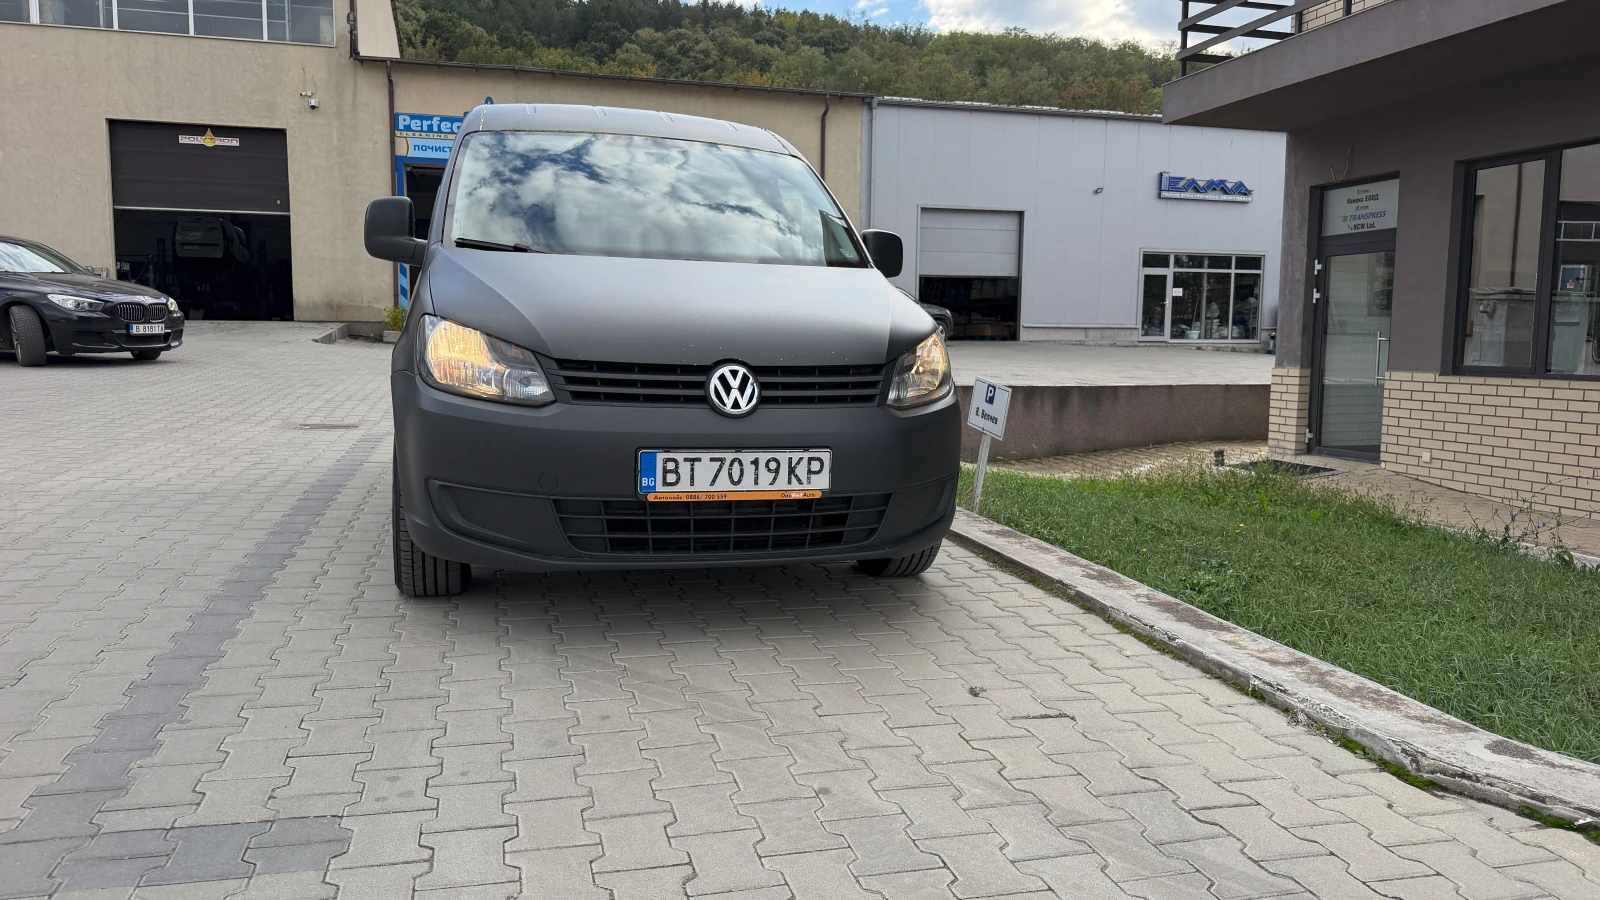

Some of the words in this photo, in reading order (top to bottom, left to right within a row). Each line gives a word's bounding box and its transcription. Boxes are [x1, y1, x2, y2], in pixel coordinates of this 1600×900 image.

[1349, 210, 1387, 222] TRANSPRESS
[1366, 221, 1376, 229] Ltd.
[641, 477, 655, 487] BG
